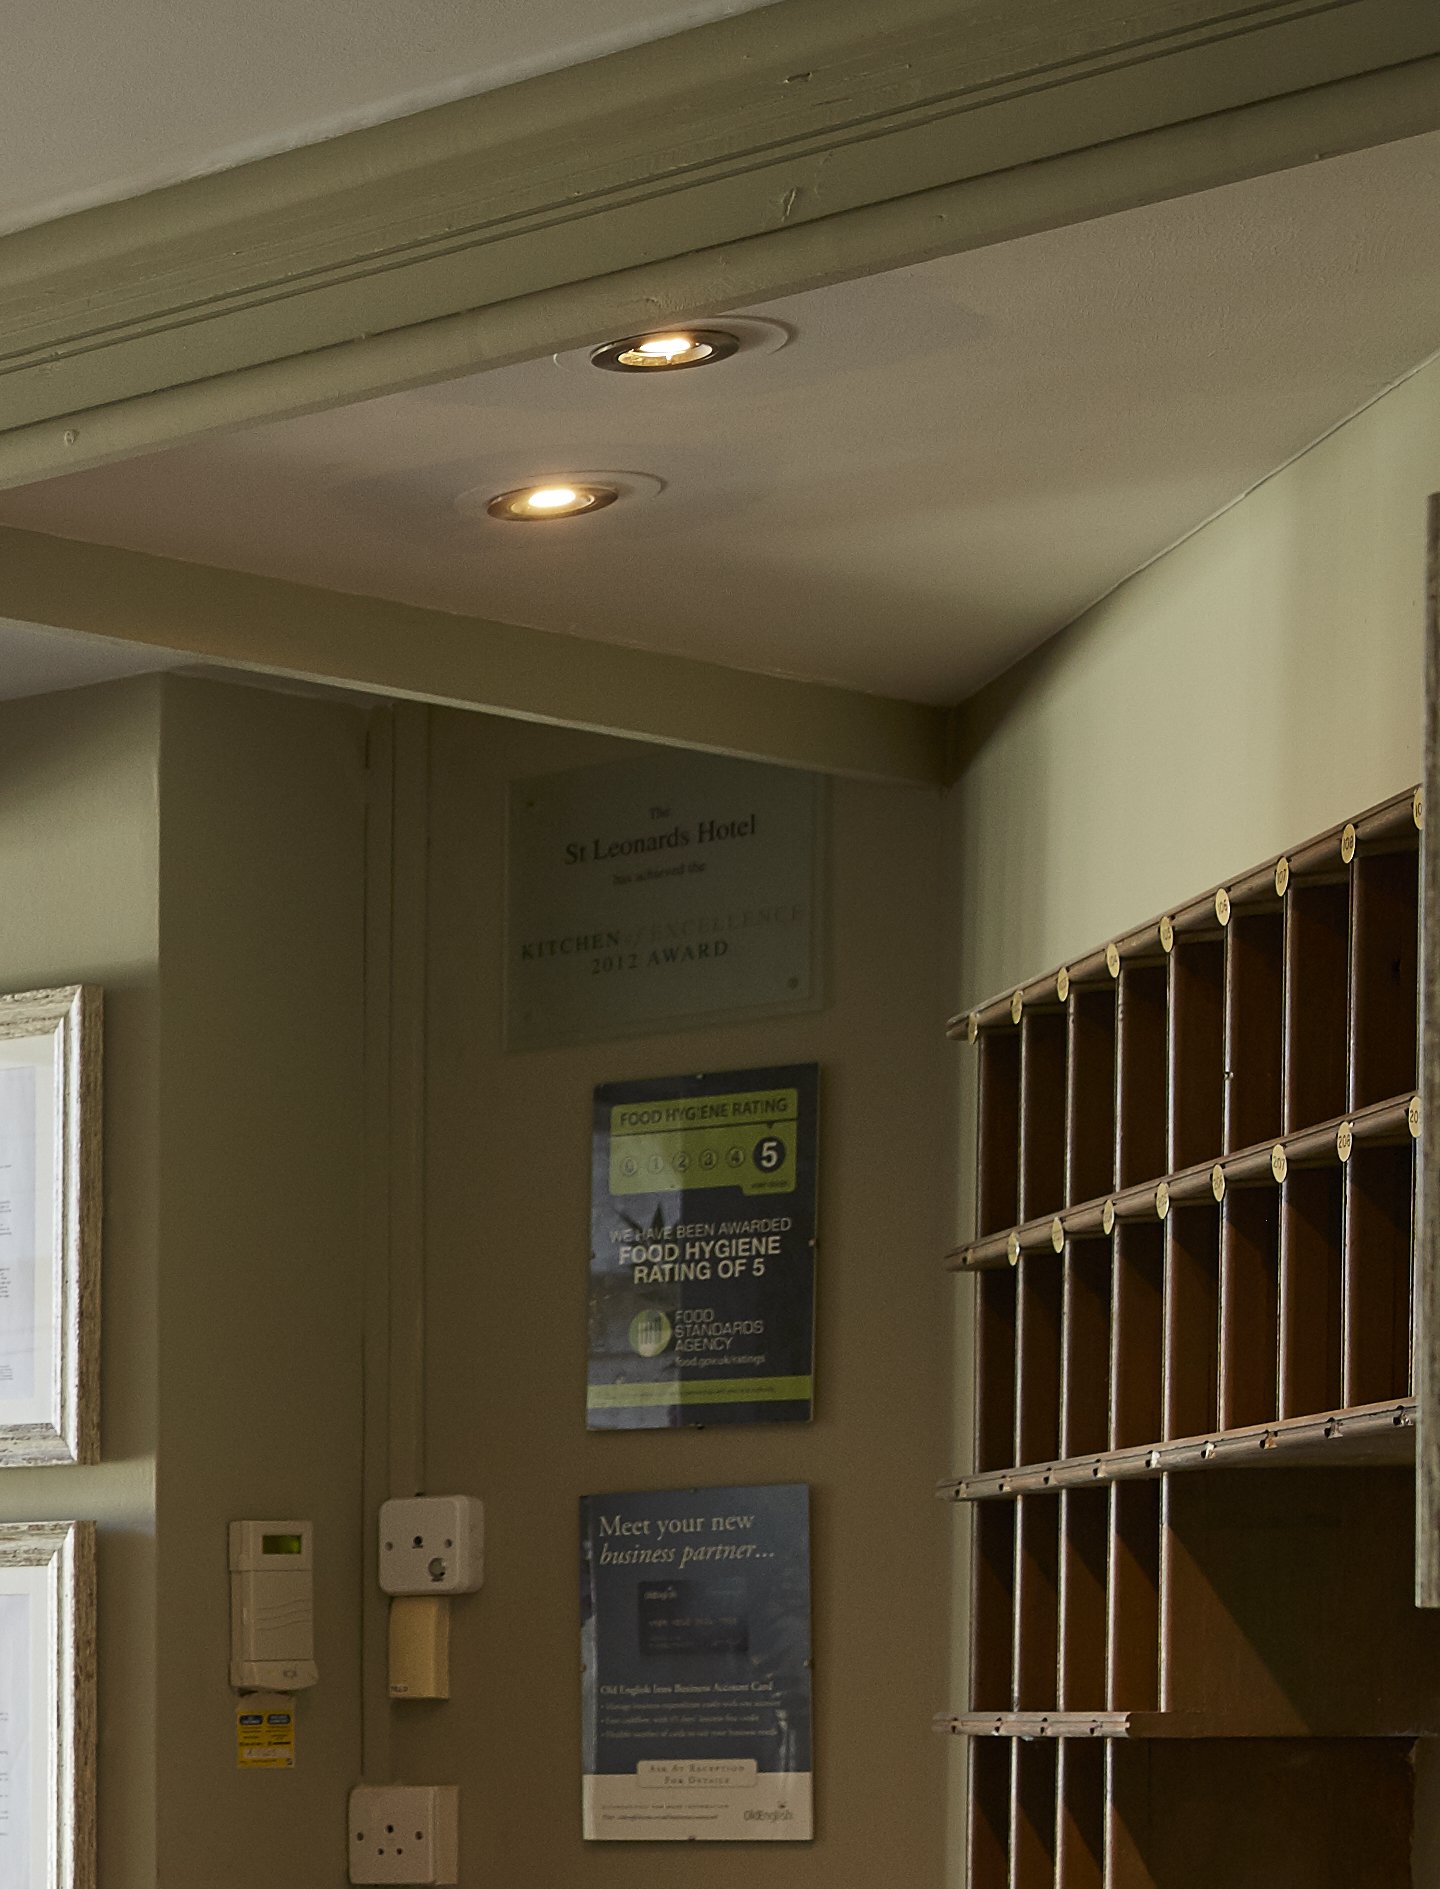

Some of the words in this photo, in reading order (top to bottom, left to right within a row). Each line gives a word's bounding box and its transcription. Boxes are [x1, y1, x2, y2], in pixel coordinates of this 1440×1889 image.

[649, 807, 671, 819] The
[564, 842, 586, 865] St
[592, 827, 691, 861] Leonards
[697, 813, 756, 844] Hotel
[687, 861, 706, 874] the
[521, 930, 621, 962] KITCHEN
[591, 954, 639, 975] 2012
[647, 939, 730, 968] AWARD
[620, 1109, 663, 1128] FOOD
[665, 1103, 729, 1122] HYGIENE
[732, 1097, 788, 1116] RATING
[760, 1140, 779, 1169] 5
[609, 1228, 633, 1243] WE
[635, 1226, 673, 1242] HAVE
[676, 1222, 715, 1239] BEEN
[718, 1217, 792, 1236] AWARDED
[618, 1243, 680, 1266] FOOD
[684, 1235, 782, 1261] HYGIENE
[633, 1260, 711, 1285] RATING
[717, 1259, 747, 1279] OF
[751, 1257, 766, 1277] 5
[675, 1308, 715, 1323] FOOD
[674, 1320, 764, 1339] STANDARDS
[674, 1337, 734, 1353] AGENCY
[599, 1514, 651, 1537] Meet
[656, 1517, 706, 1541] your
[711, 1514, 756, 1531] new
[599, 1542, 675, 1566] business
[678, 1542, 776, 1569] partner...
